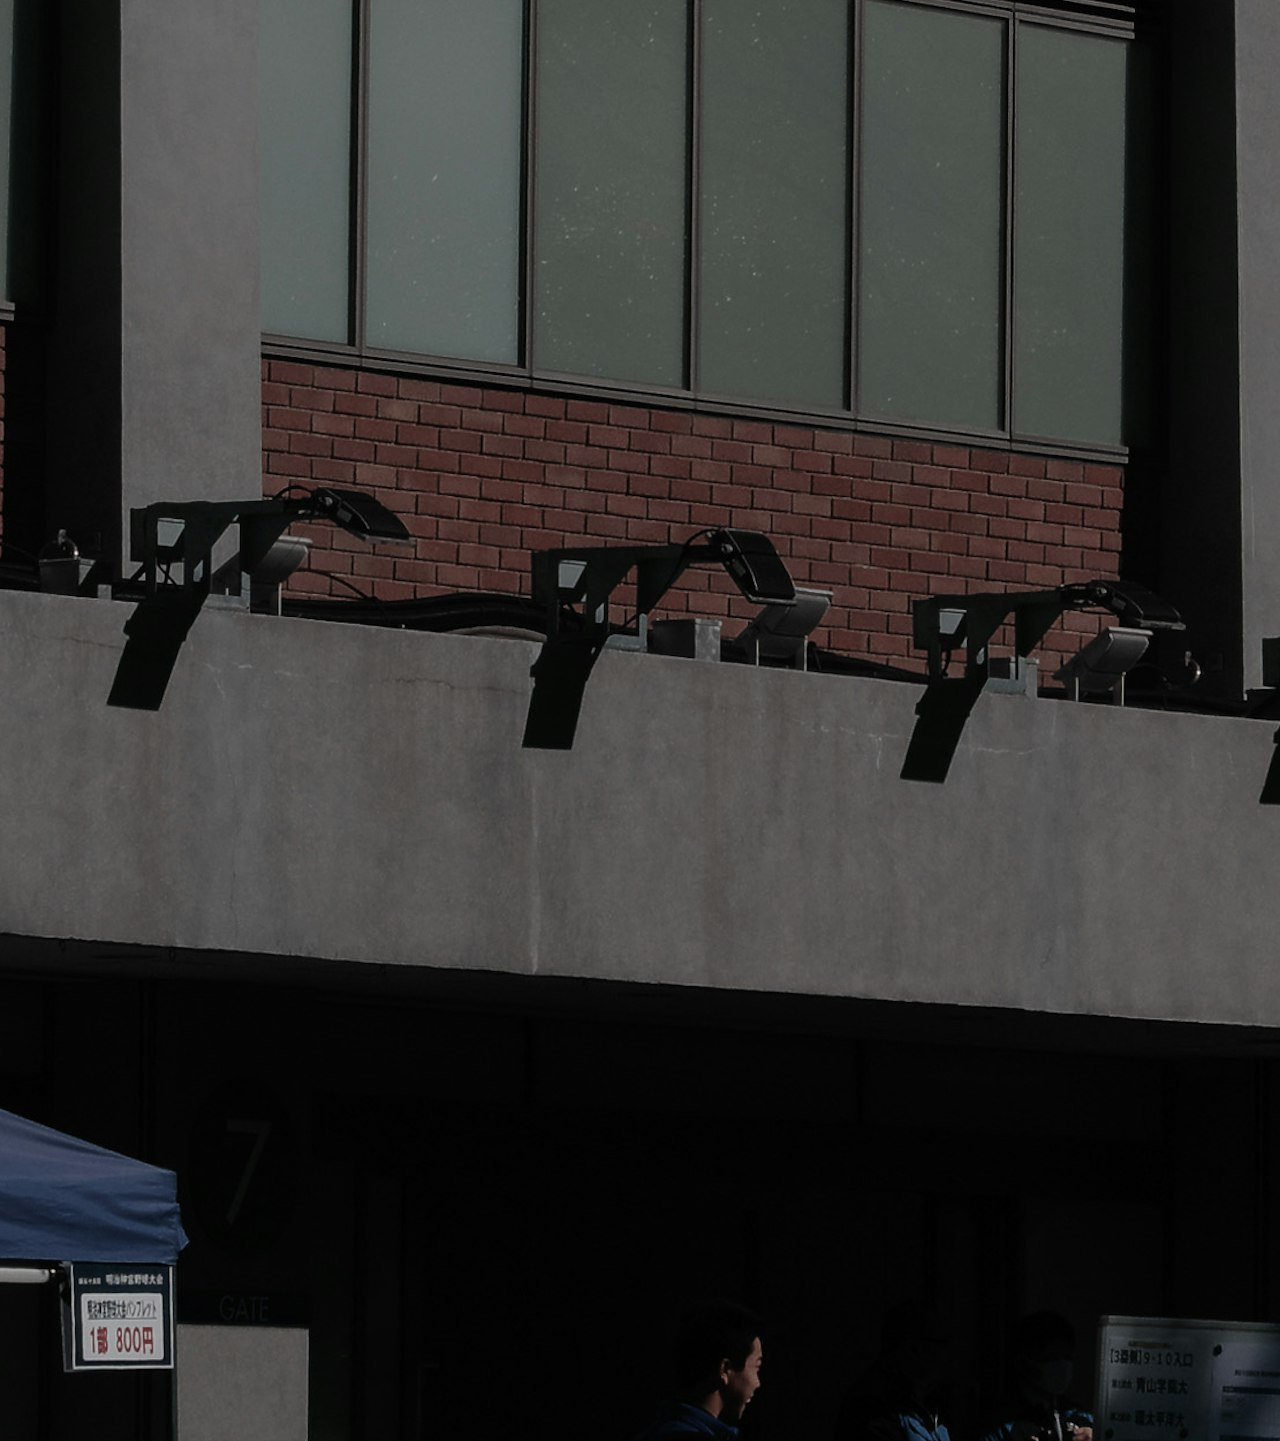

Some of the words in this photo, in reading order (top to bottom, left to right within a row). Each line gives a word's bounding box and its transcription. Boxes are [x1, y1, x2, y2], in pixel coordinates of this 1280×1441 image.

[226, 1118, 272, 1225] 7
[219, 1295, 270, 1323] GATE
[90, 1326, 108, 1354] 1部
[116, 1326, 154, 1354] 800円
